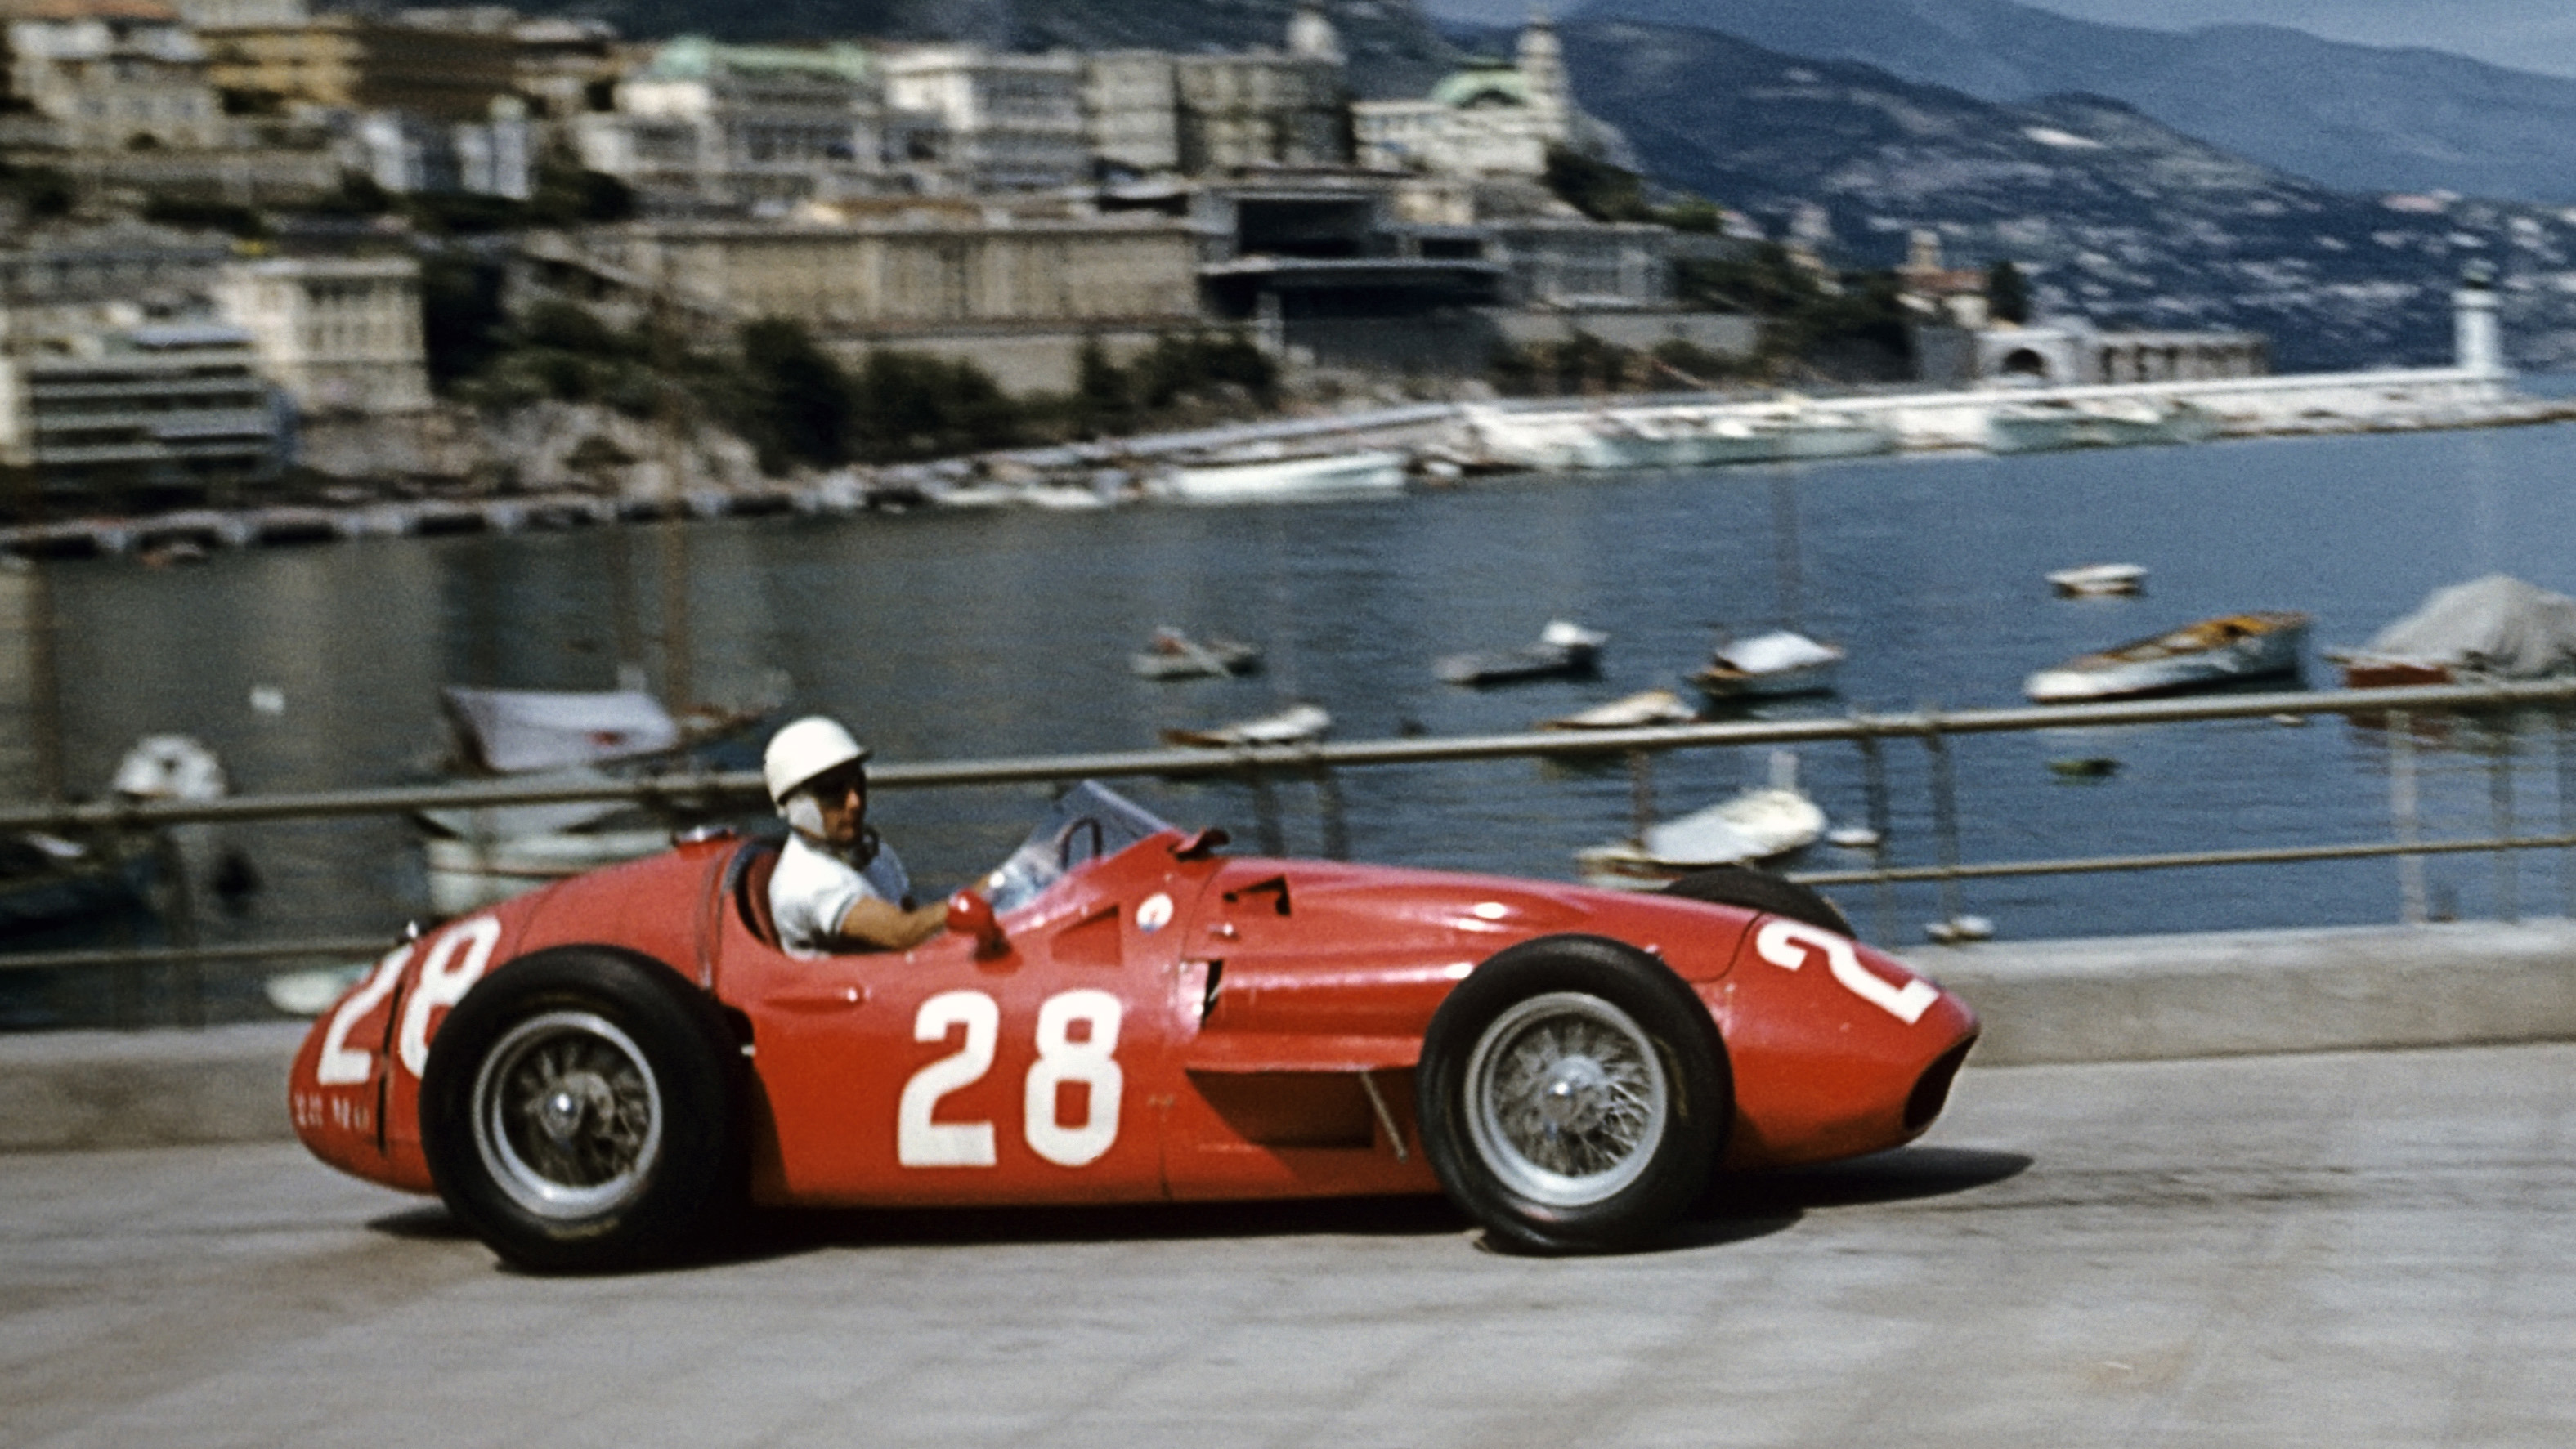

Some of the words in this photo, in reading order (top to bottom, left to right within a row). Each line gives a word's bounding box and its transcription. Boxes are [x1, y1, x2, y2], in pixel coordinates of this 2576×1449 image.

[317, 913, 502, 1085] 28
[1756, 917, 1940, 1025] 2
[898, 987, 1124, 1167] 28
